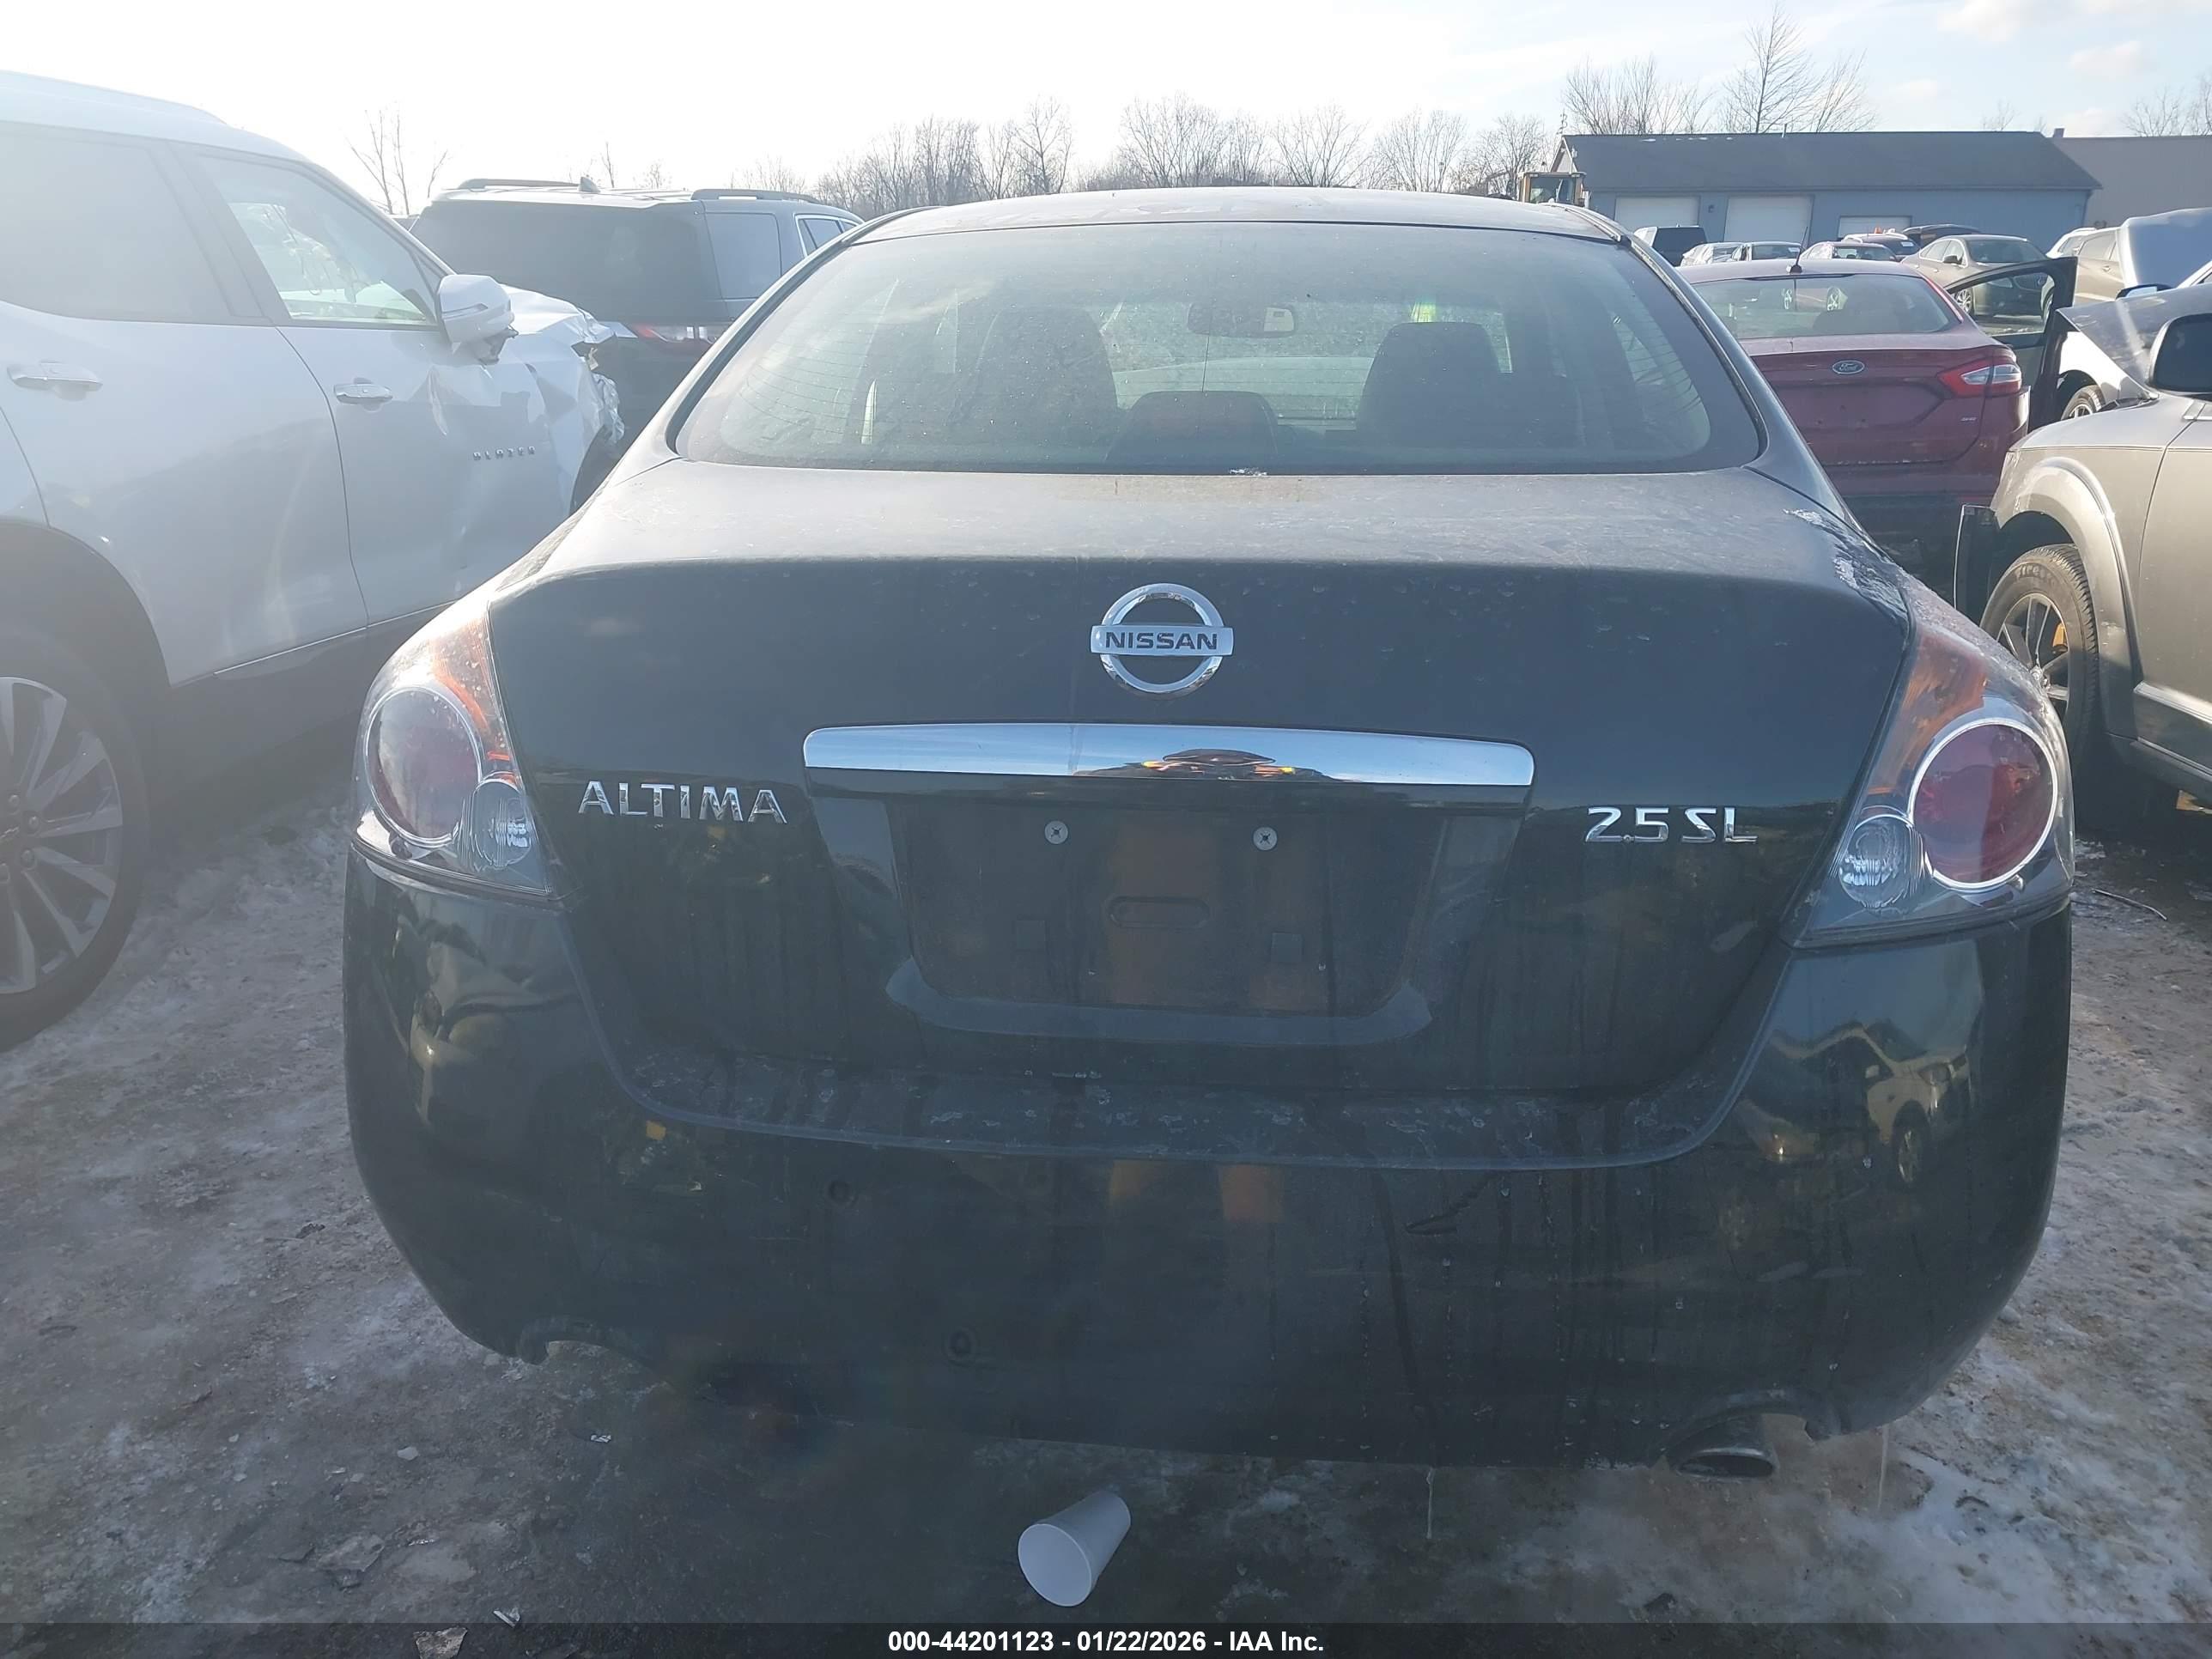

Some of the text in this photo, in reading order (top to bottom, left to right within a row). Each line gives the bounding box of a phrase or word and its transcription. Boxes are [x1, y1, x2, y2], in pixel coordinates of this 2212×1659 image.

[473, 446, 536, 460] BLAZER
[1105, 631, 1218, 650] NISSAN
[578, 781, 788, 824] ALTIMA
[1585, 806, 1759, 843] 2.5 SL
